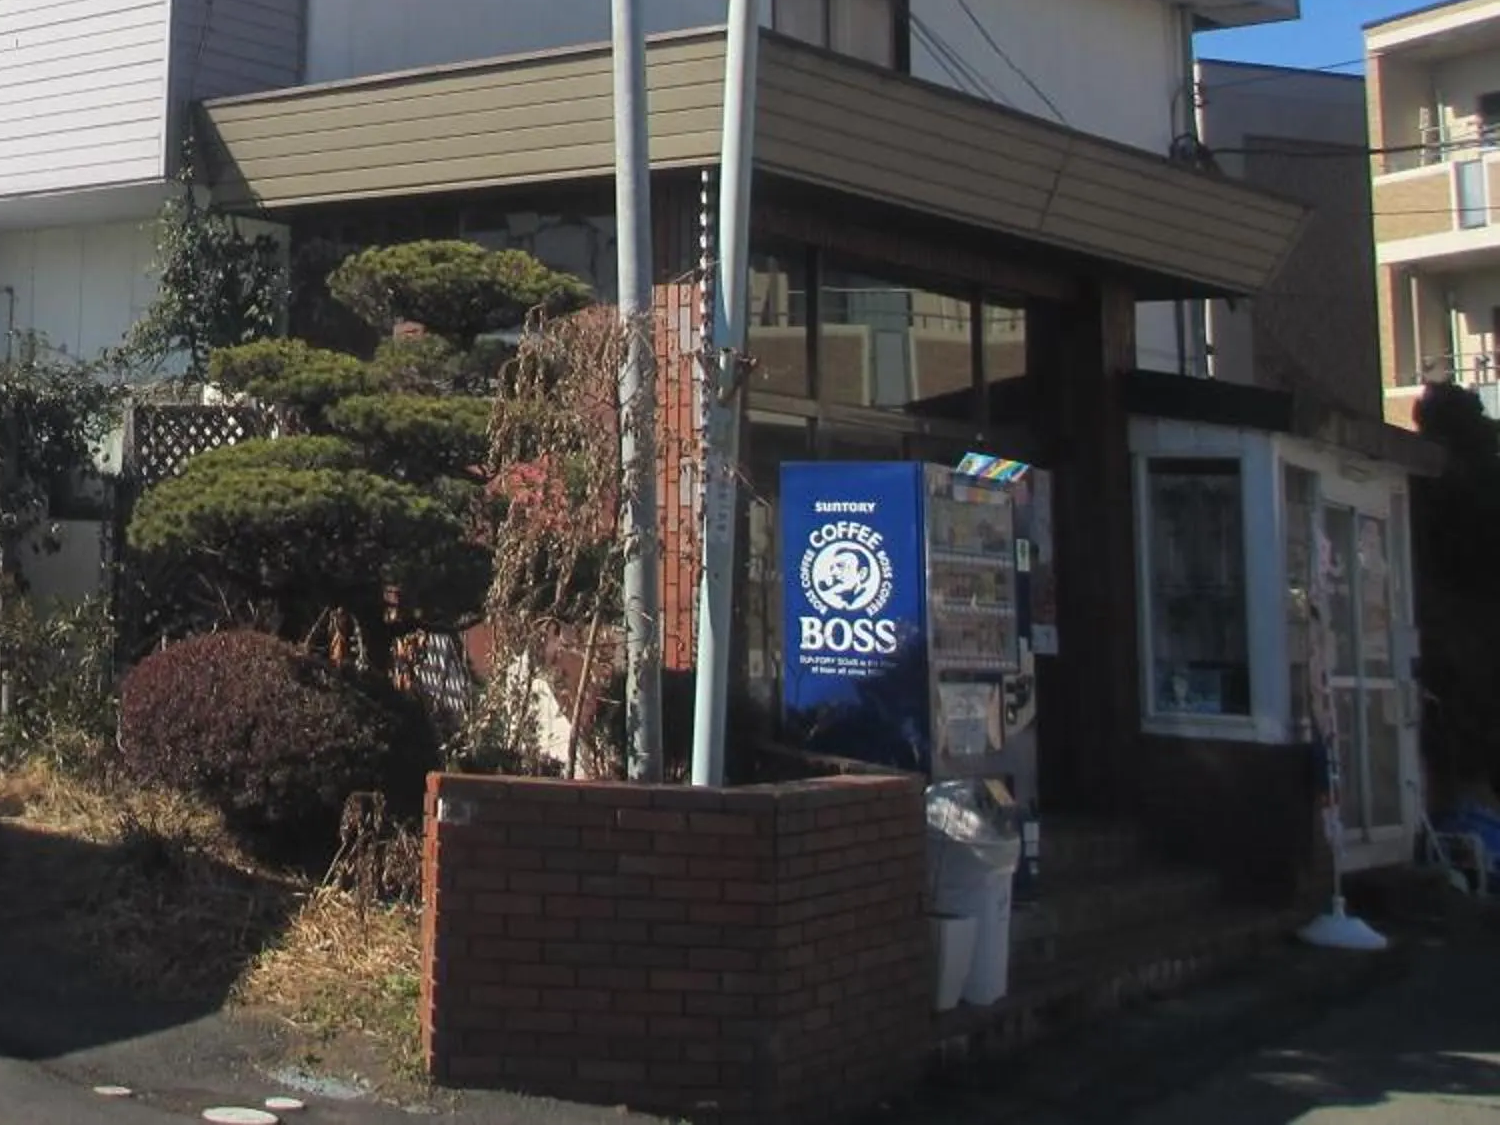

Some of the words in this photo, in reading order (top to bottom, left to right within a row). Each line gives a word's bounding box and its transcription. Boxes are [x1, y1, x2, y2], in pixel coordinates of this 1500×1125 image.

[815, 501, 877, 513] SUNTORY
[809, 521, 883, 550] COFFEE
[799, 616, 898, 654] BOSS
